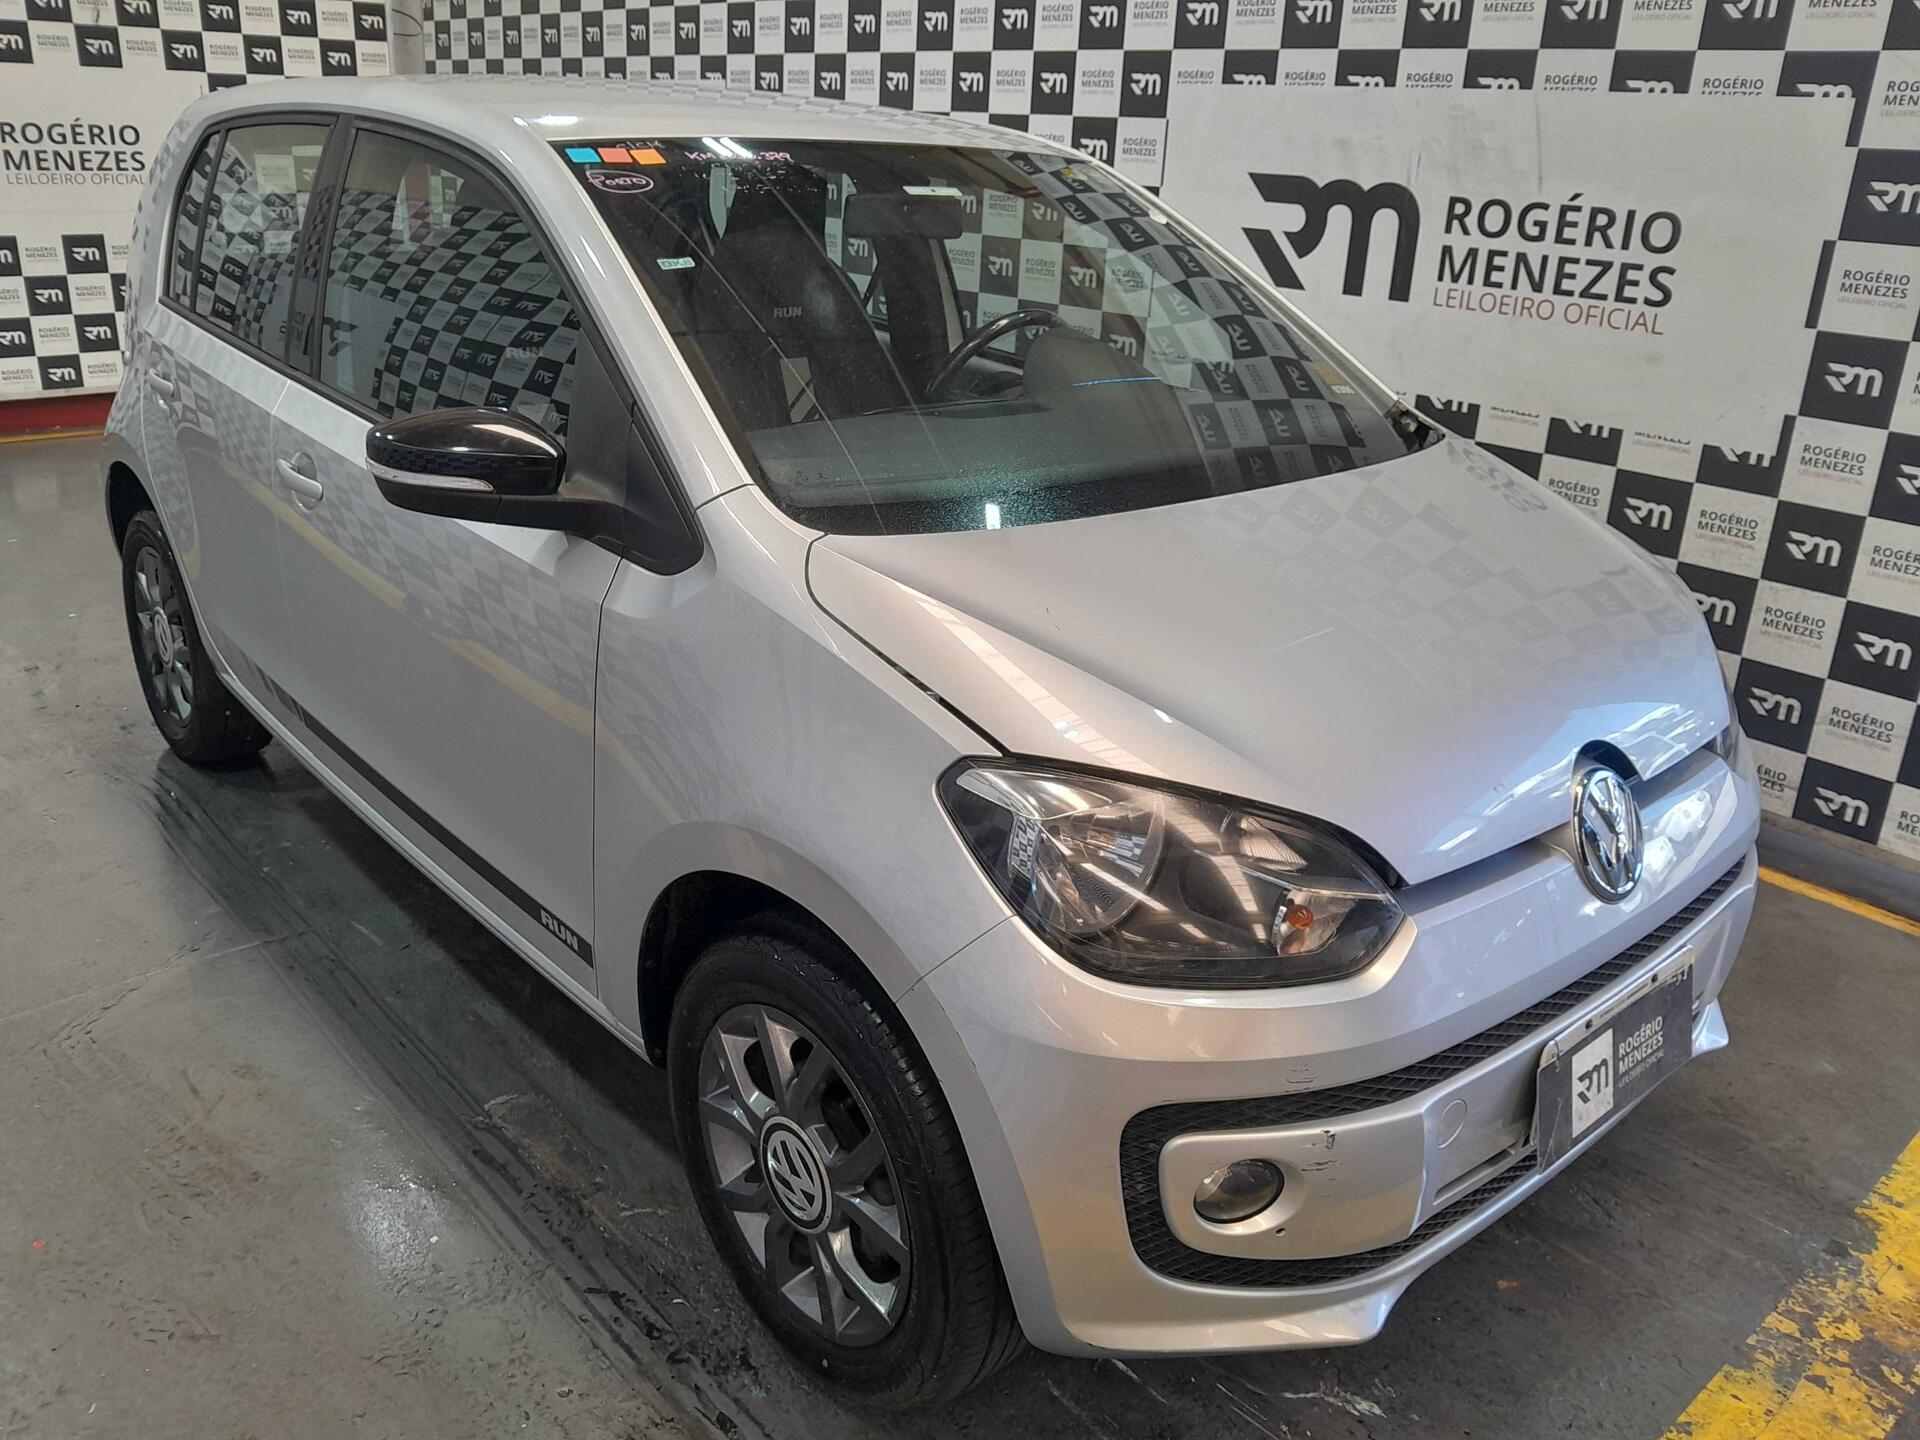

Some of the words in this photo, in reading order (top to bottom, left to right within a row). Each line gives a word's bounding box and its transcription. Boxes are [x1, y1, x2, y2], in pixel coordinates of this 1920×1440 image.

[1236, 8, 1276, 18] MENEZES
[1352, 5, 1397, 15] MENEZES
[1484, 2, 1536, 13] MENEZES
[1634, 0, 1693, 11] MENEZES
[1284, 70, 1326, 81] ROGÉRIO
[1406, 71, 1454, 83] ROGÉRIO
[1544, 73, 1598, 86] ROGÉRIO
[1703, 75, 1764, 90] ROGÉRIO
[0, 117, 140, 145] ROGÉRIO
[3, 149, 146, 172] MENEZES
[6, 173, 86, 185] LEILOEIRO
[90, 173, 145, 185] OFICIAL
[1444, 192, 1682, 254] ROGÉRIO
[1437, 245, 1677, 308] MENEZES
[1842, 269, 1910, 286] ROGÉRIO
[1840, 282, 1908, 299] MENEZES
[773, 306, 802, 318] RUN
[1433, 287, 1555, 321] LEILOEIRO
[1564, 303, 1664, 336] OFICIAL
[1802, 444, 1866, 464] ROGÉRIO
[1800, 455, 1864, 476] MENEZES
[1548, 478, 1600, 497] ROGÉRIO
[1700, 509, 1758, 530] ROGÉRIO
[1697, 520, 1756, 542] MENEZES
[1765, 606, 1826, 630] ROGÉRIO
[1762, 617, 1824, 640] MENEZES
[1831, 706, 1895, 732] ROGÉRIO
[1828, 717, 1894, 744] MENEZES
[1757, 764, 1787, 782] ÉRIO
[540, 908, 578, 952] RUN
[1619, 1016, 1663, 1058] ROGÉRIO
[1619, 1031, 1664, 1074] MENEZES
